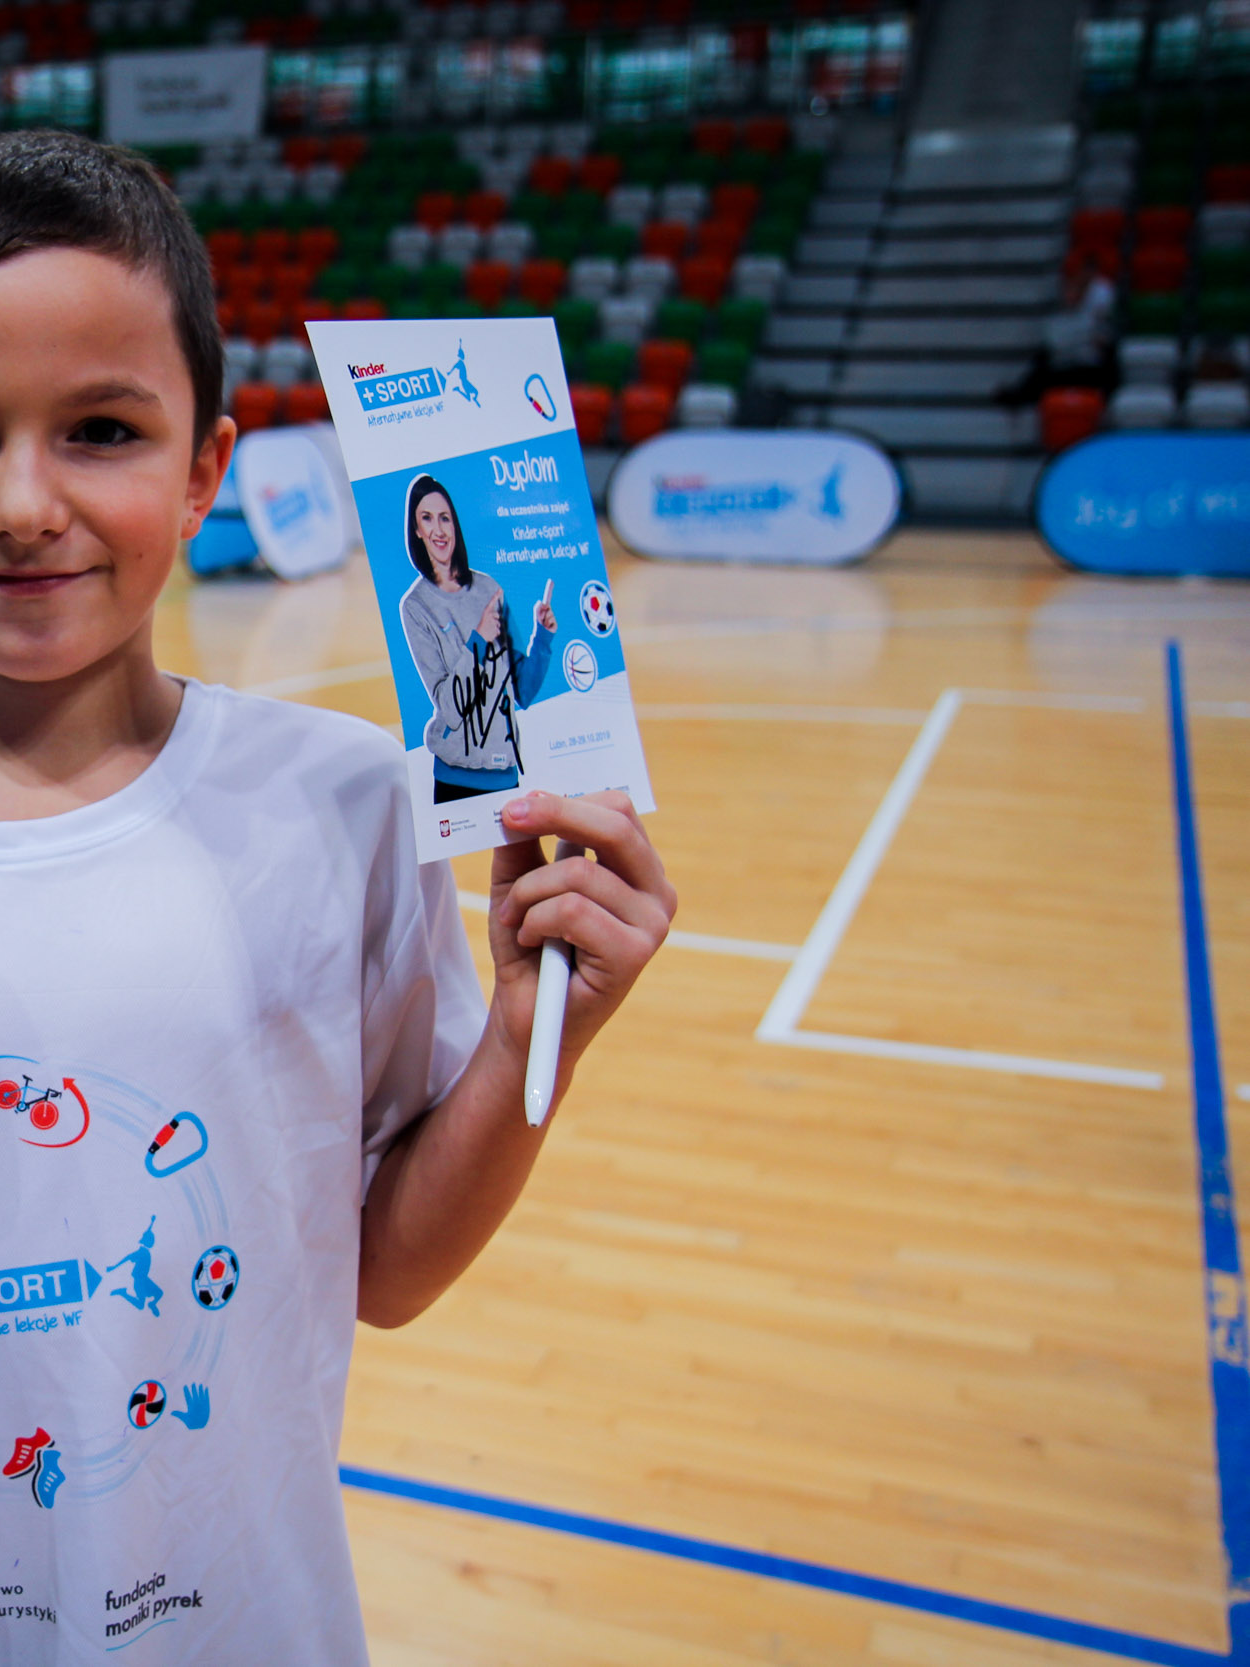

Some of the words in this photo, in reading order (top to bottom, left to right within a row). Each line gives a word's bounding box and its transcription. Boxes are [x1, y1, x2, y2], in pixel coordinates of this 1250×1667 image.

[489, 449, 559, 492] Dyplom
[510, 501, 549, 516] uczestnika
[512, 522, 565, 541] Kinder+Sport
[496, 546, 549, 565] Alternatywne
[550, 542, 578, 560] Lekcje
[578, 541, 590, 556] WF
[15, 1313, 59, 1333] lekcje
[63, 1310, 84, 1327] WF
[105, 1572, 166, 1611] fundacja
[105, 1600, 151, 1637] moniki
[152, 1589, 204, 1619] pyrek
